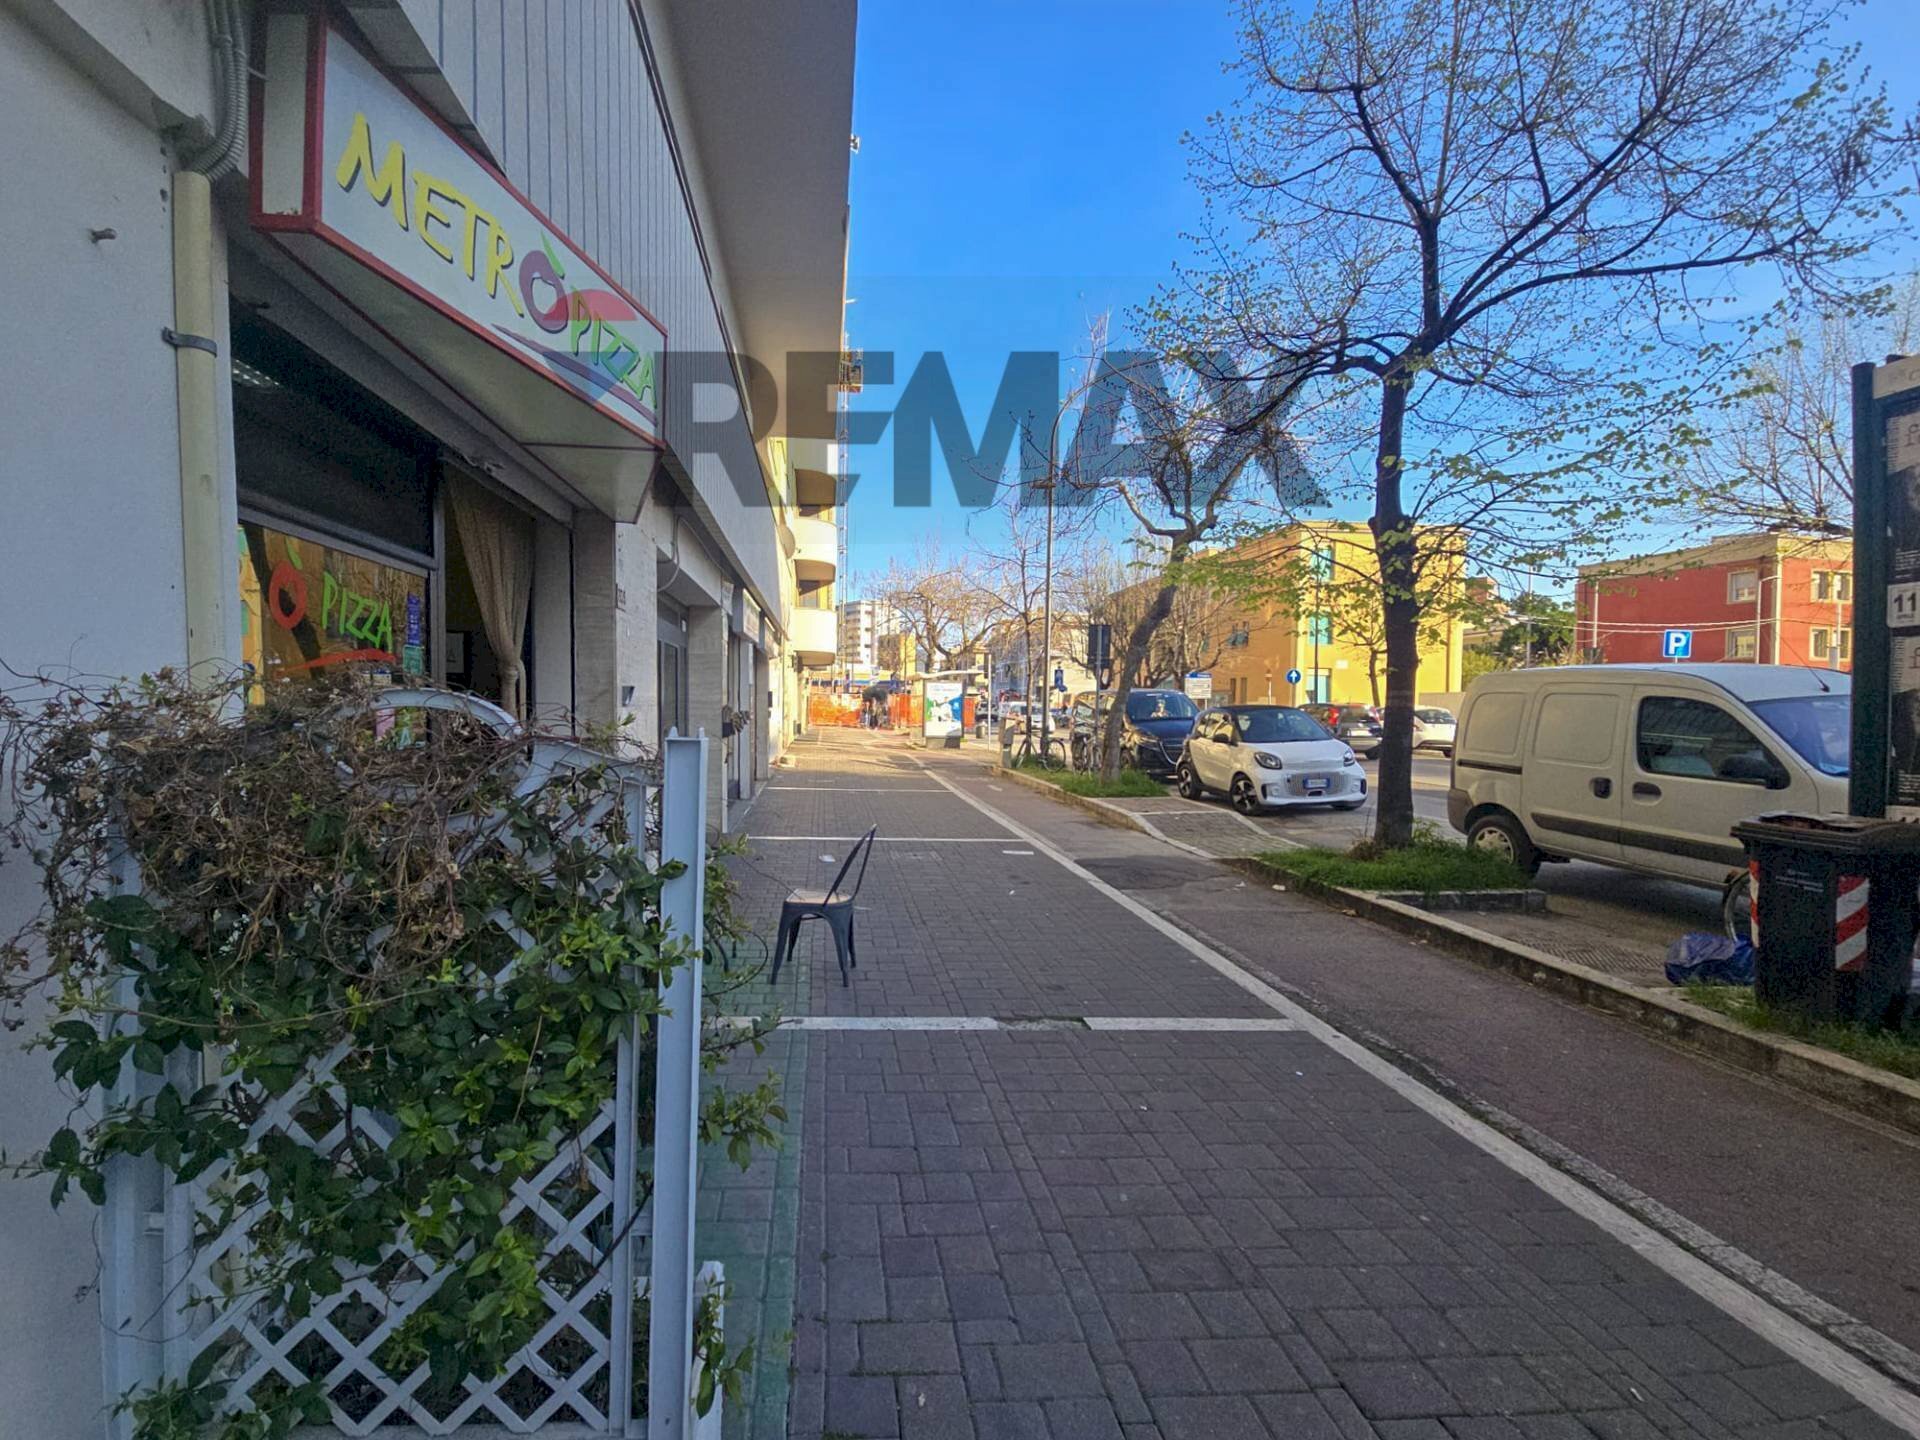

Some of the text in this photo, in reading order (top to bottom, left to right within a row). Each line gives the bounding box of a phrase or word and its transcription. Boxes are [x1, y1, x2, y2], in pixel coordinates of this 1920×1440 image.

[336, 112, 657, 409] METRO PIZZA
[321, 569, 393, 655] PIZZA
[1669, 632, 1687, 655] P
